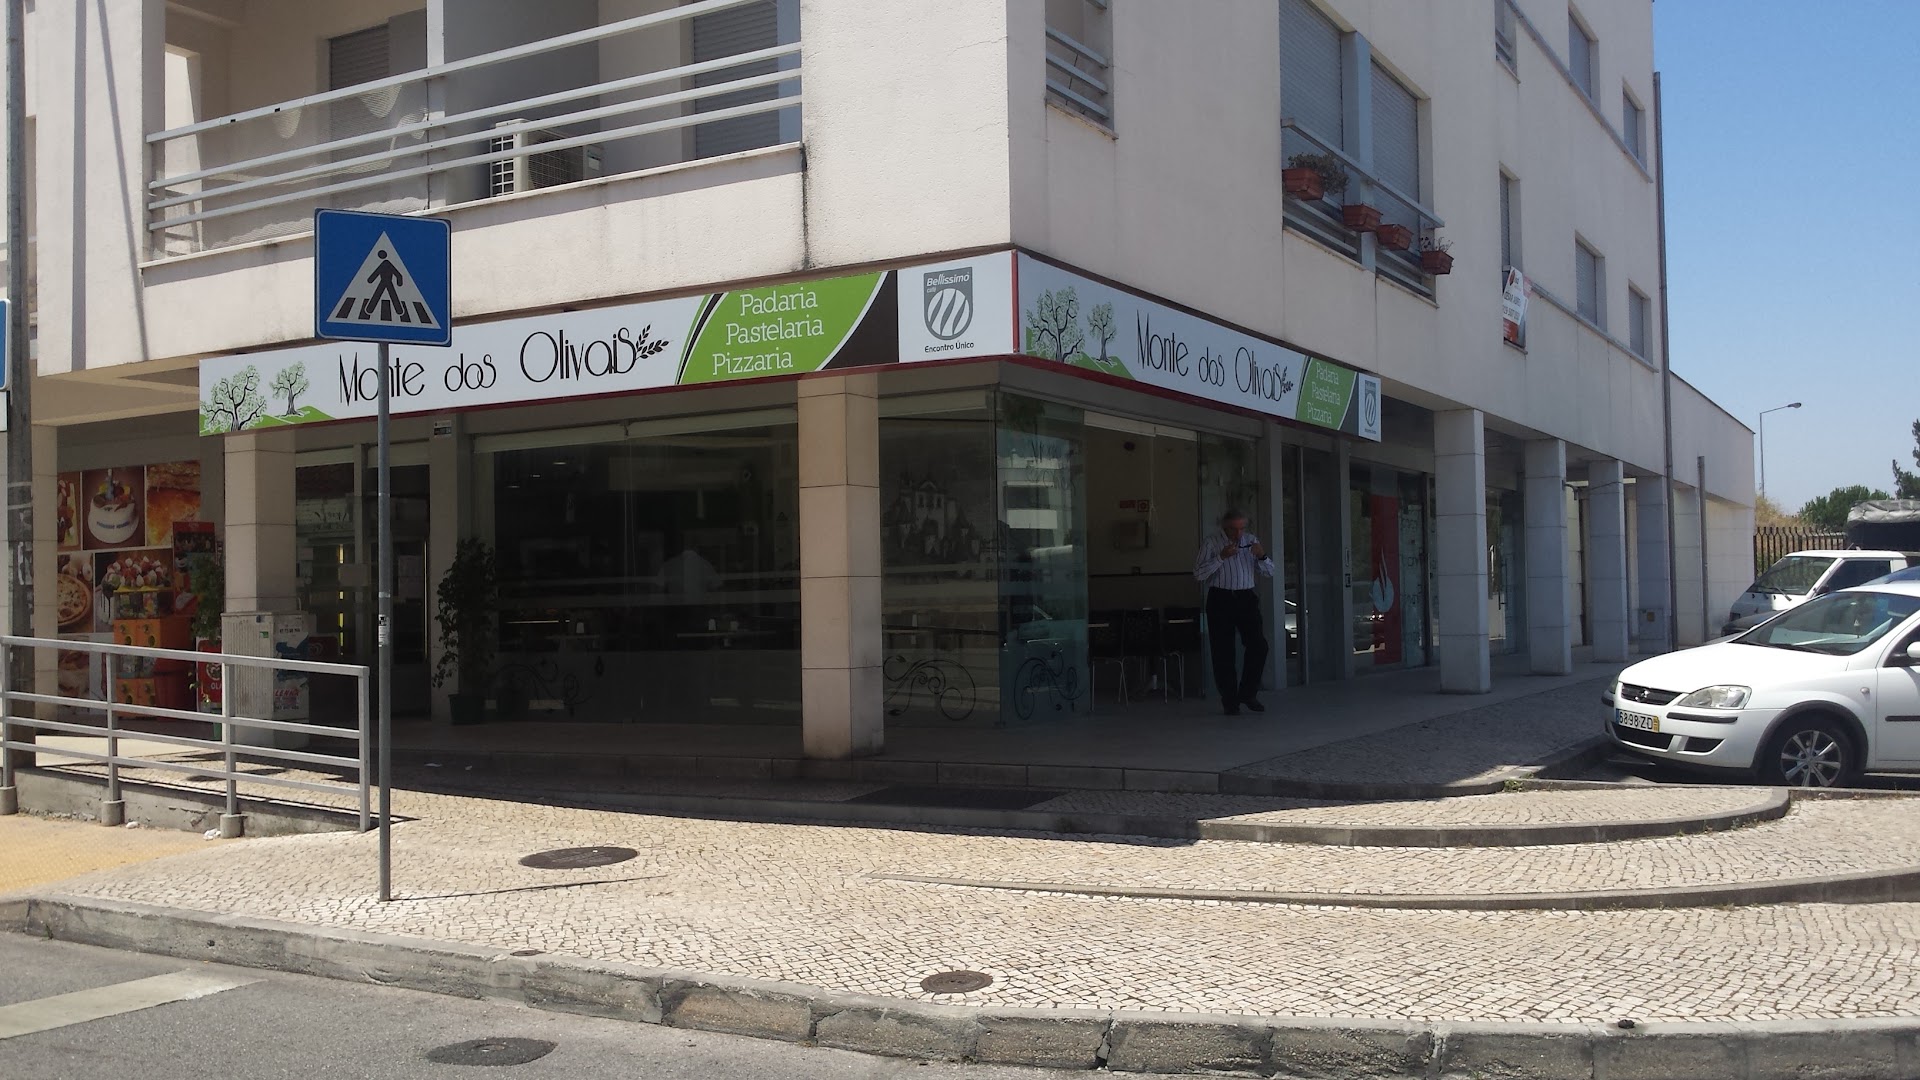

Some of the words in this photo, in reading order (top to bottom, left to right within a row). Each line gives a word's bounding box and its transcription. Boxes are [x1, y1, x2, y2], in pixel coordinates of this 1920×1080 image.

[926, 274, 969, 287] Bellissimo
[740, 286, 818, 316] Padaria
[726, 315, 824, 345] Pastelaria
[444, 353, 497, 392] dos
[519, 327, 637, 382] Olivais
[925, 343, 954, 353] Encontro
[955, 341, 974, 350] Único
[1137, 310, 1189, 377] Monte
[1198, 347, 1225, 387] dos
[1235, 346, 1282, 402] Olivais
[712, 347, 794, 376] Pizzaria
[1316, 362, 1339, 385] Padaria
[1311, 382, 1341, 405] Pastelaria
[1307, 402, 1332, 424] Pizzaria
